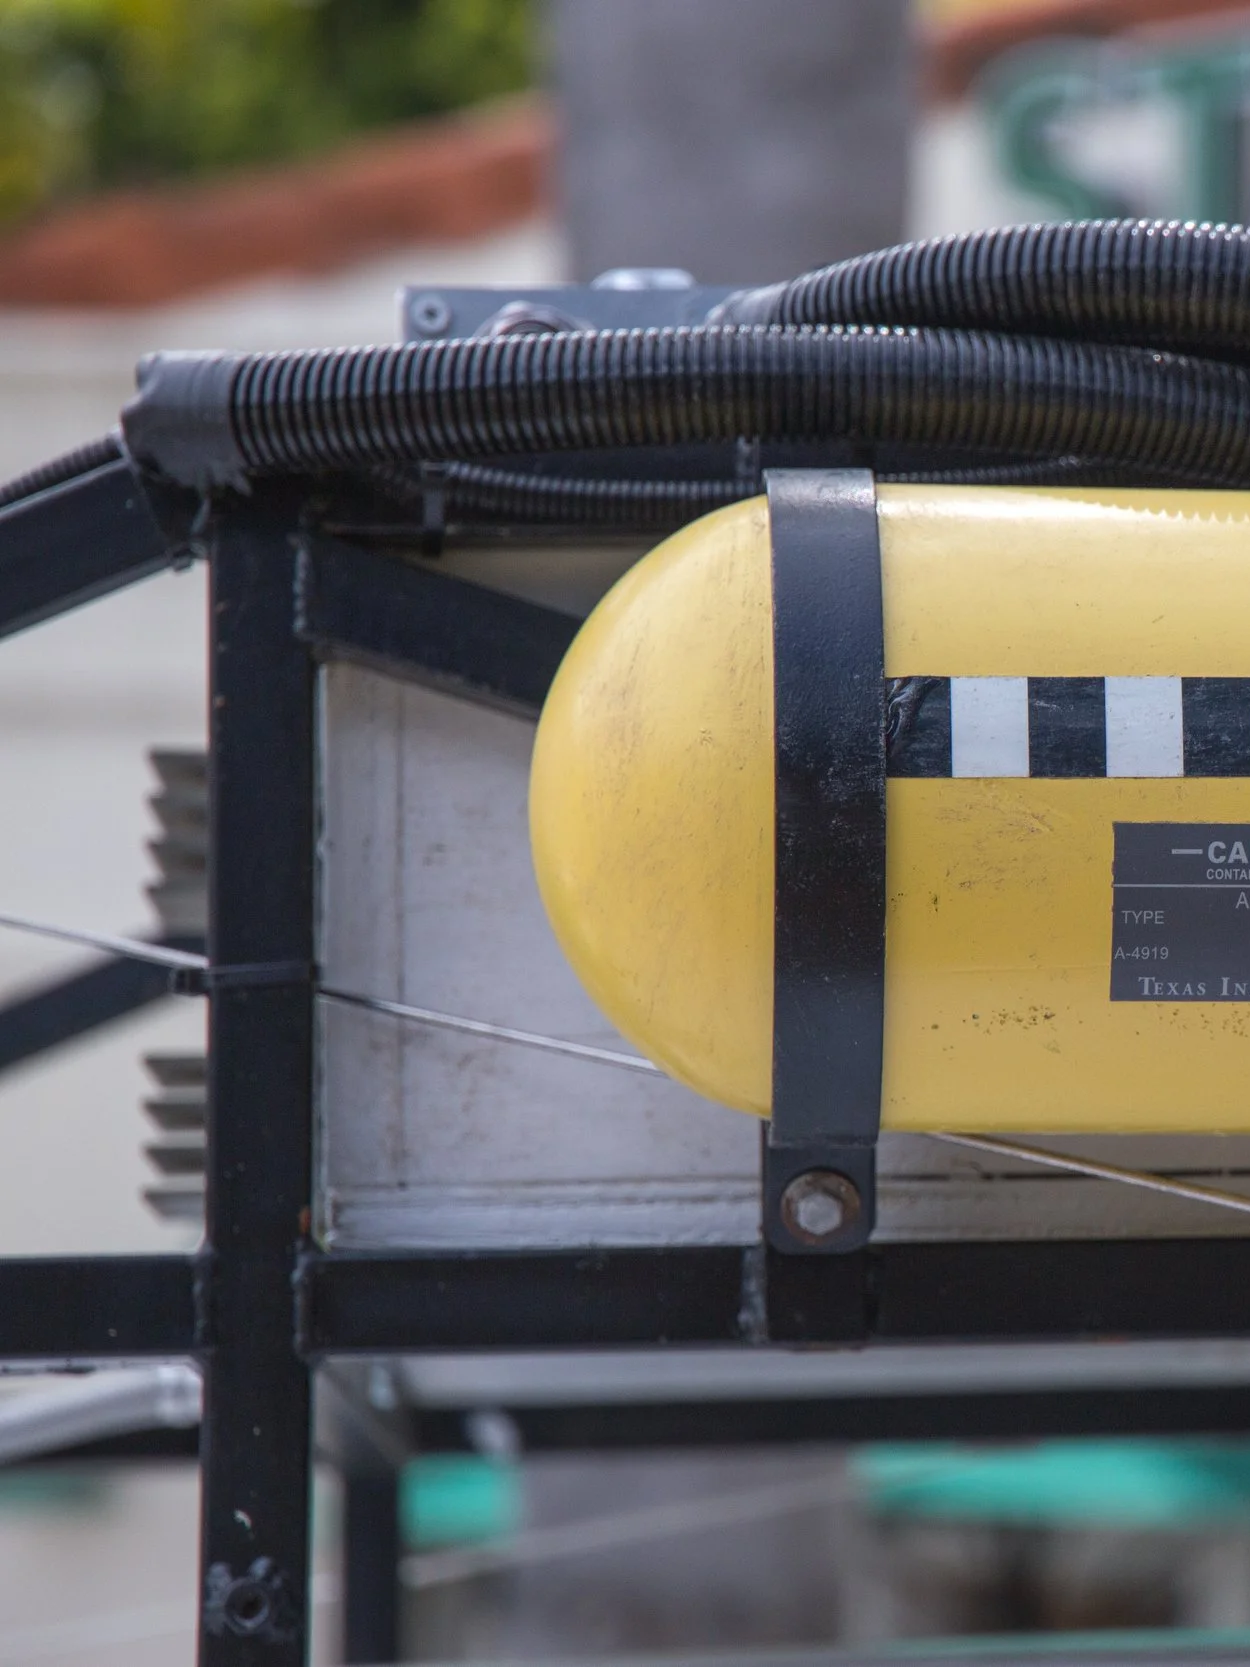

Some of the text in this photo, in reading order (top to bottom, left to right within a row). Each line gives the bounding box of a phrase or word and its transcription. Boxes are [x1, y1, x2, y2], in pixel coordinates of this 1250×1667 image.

[1122, 911, 1165, 925] TYPE
[1114, 946, 1169, 960] A-4919
[1138, 976, 1207, 996] TEXAS
